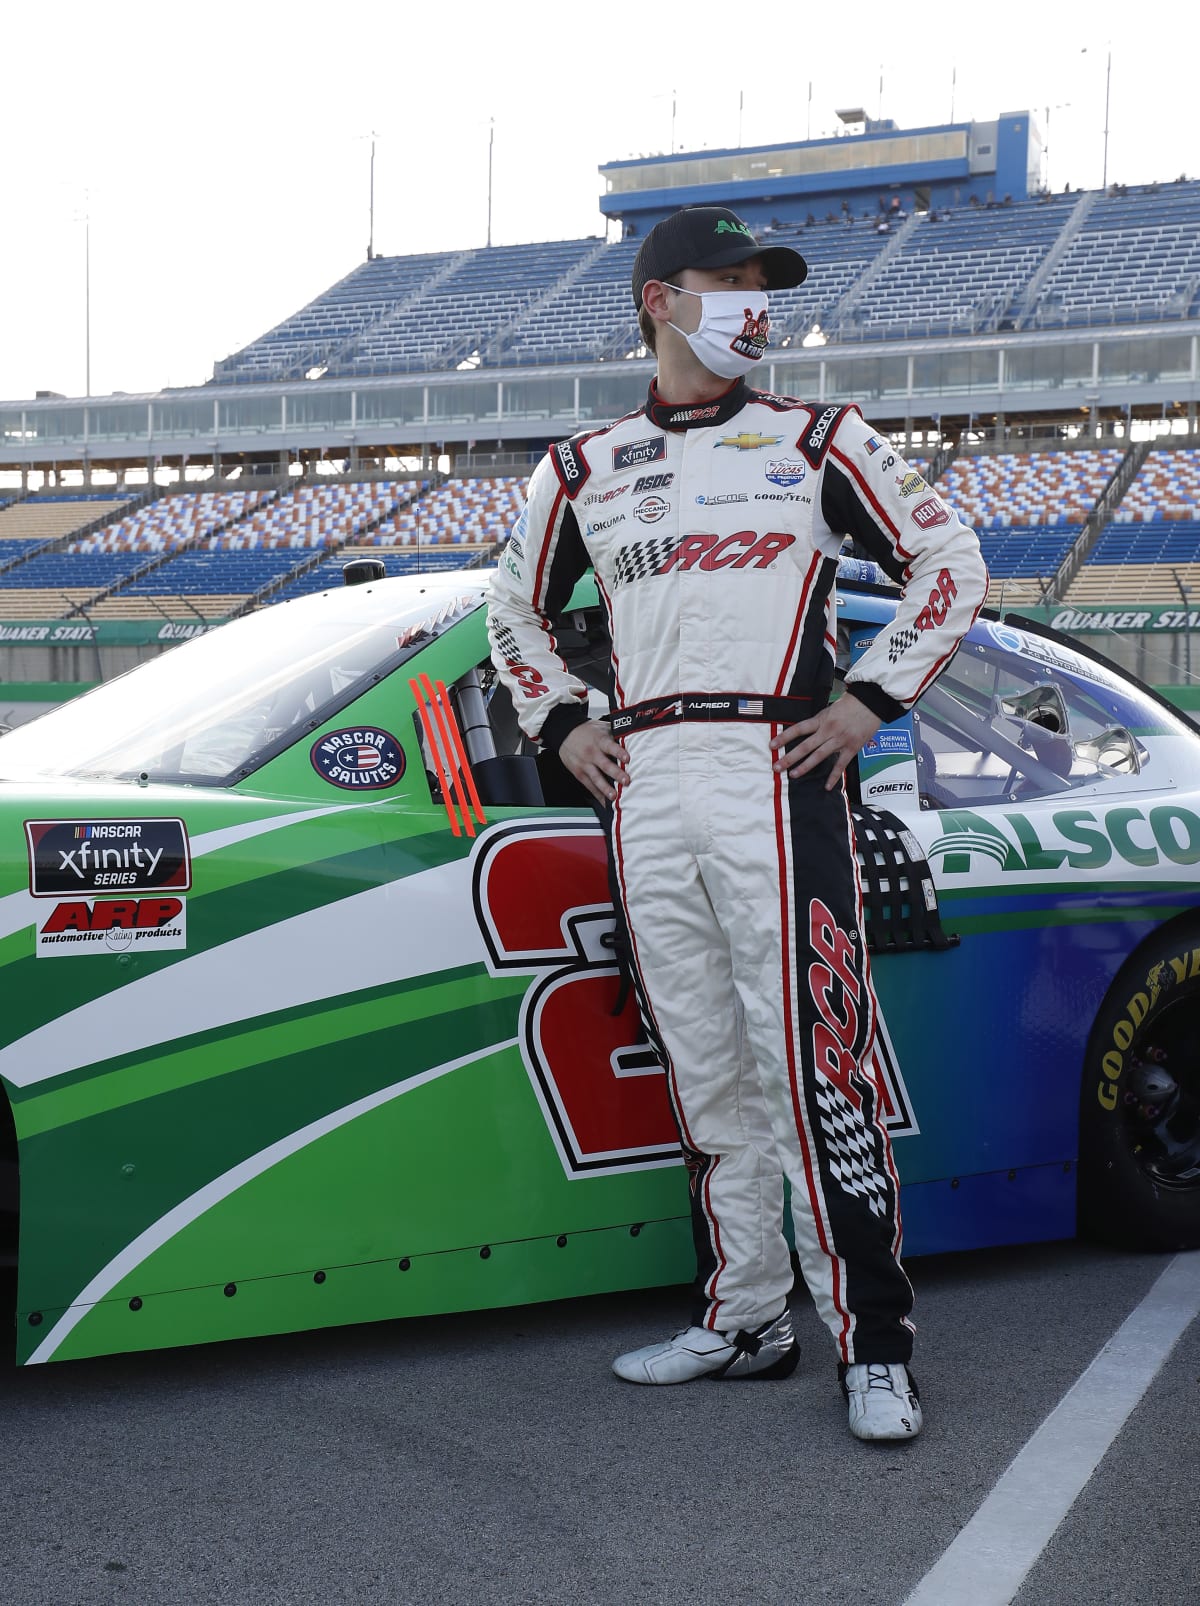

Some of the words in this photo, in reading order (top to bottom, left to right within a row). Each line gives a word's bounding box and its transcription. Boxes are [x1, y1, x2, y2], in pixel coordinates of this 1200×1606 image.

[809, 407, 841, 449] sparco
[621, 446, 658, 463] xfinity
[770, 466, 803, 474] LUCAS
[592, 513, 626, 532] OKUMA
[657, 530, 796, 575] RCR
[915, 567, 958, 631] RCR
[1050, 610, 1152, 630] QUAKER
[50, 626, 99, 641] STATE
[321, 731, 386, 754] NASCAR
[328, 761, 397, 785] SALUTES
[869, 782, 914, 794] COMETIC
[90, 825, 142, 839] NASCAR
[927, 805, 1200, 873] ALSCO
[58, 841, 164, 879] xfinity
[93, 872, 138, 886] SERIES
[40, 897, 183, 934] ARP
[41, 928, 104, 944] automotive
[135, 927, 182, 941] products
[808, 897, 864, 1112] RCR
